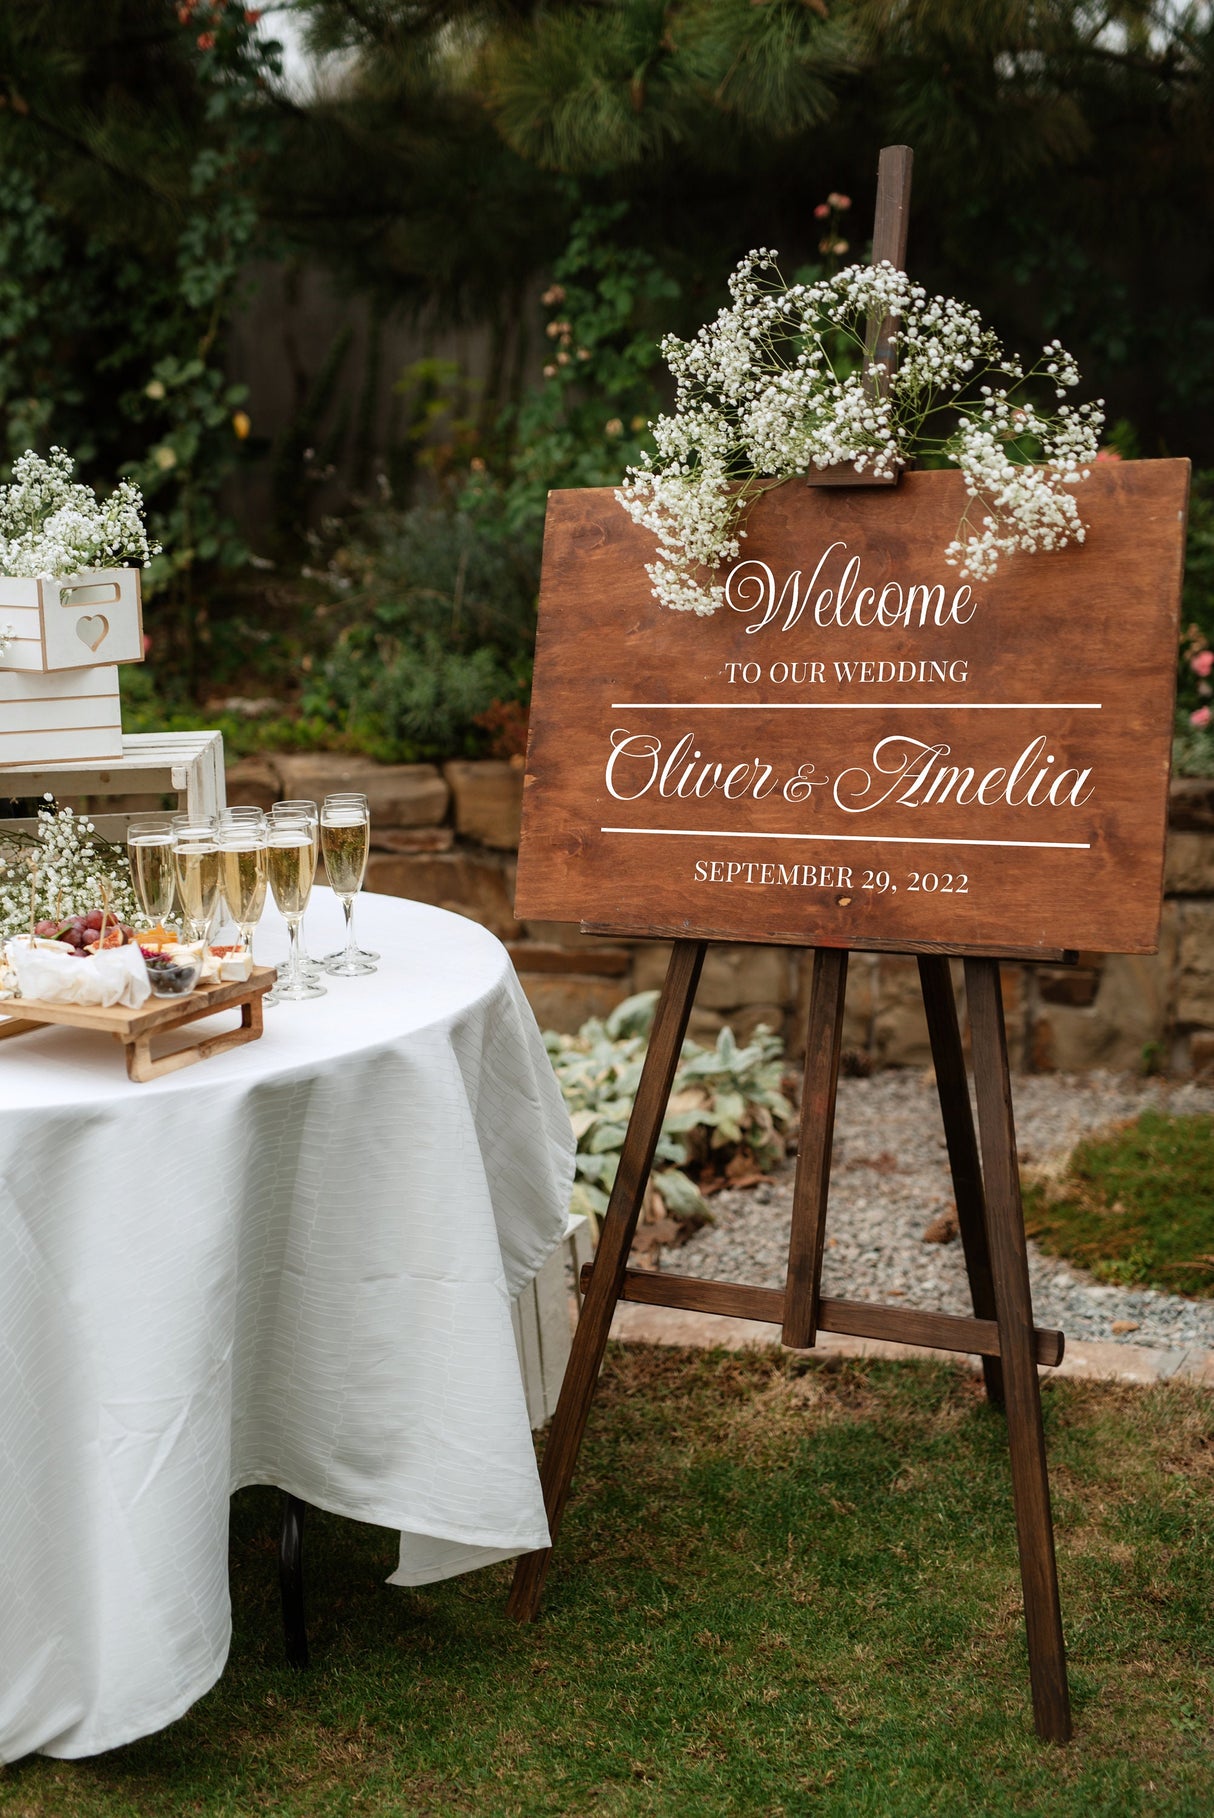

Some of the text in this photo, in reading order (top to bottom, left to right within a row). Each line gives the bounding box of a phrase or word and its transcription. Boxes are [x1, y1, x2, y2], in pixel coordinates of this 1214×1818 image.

[725, 541, 977, 634] Welcome
[724, 661, 969, 685] TO OUR WEDDING
[605, 728, 1095, 813] Oliver & Amelia
[694, 861, 970, 895] SEPTEMBER 29, 2022
